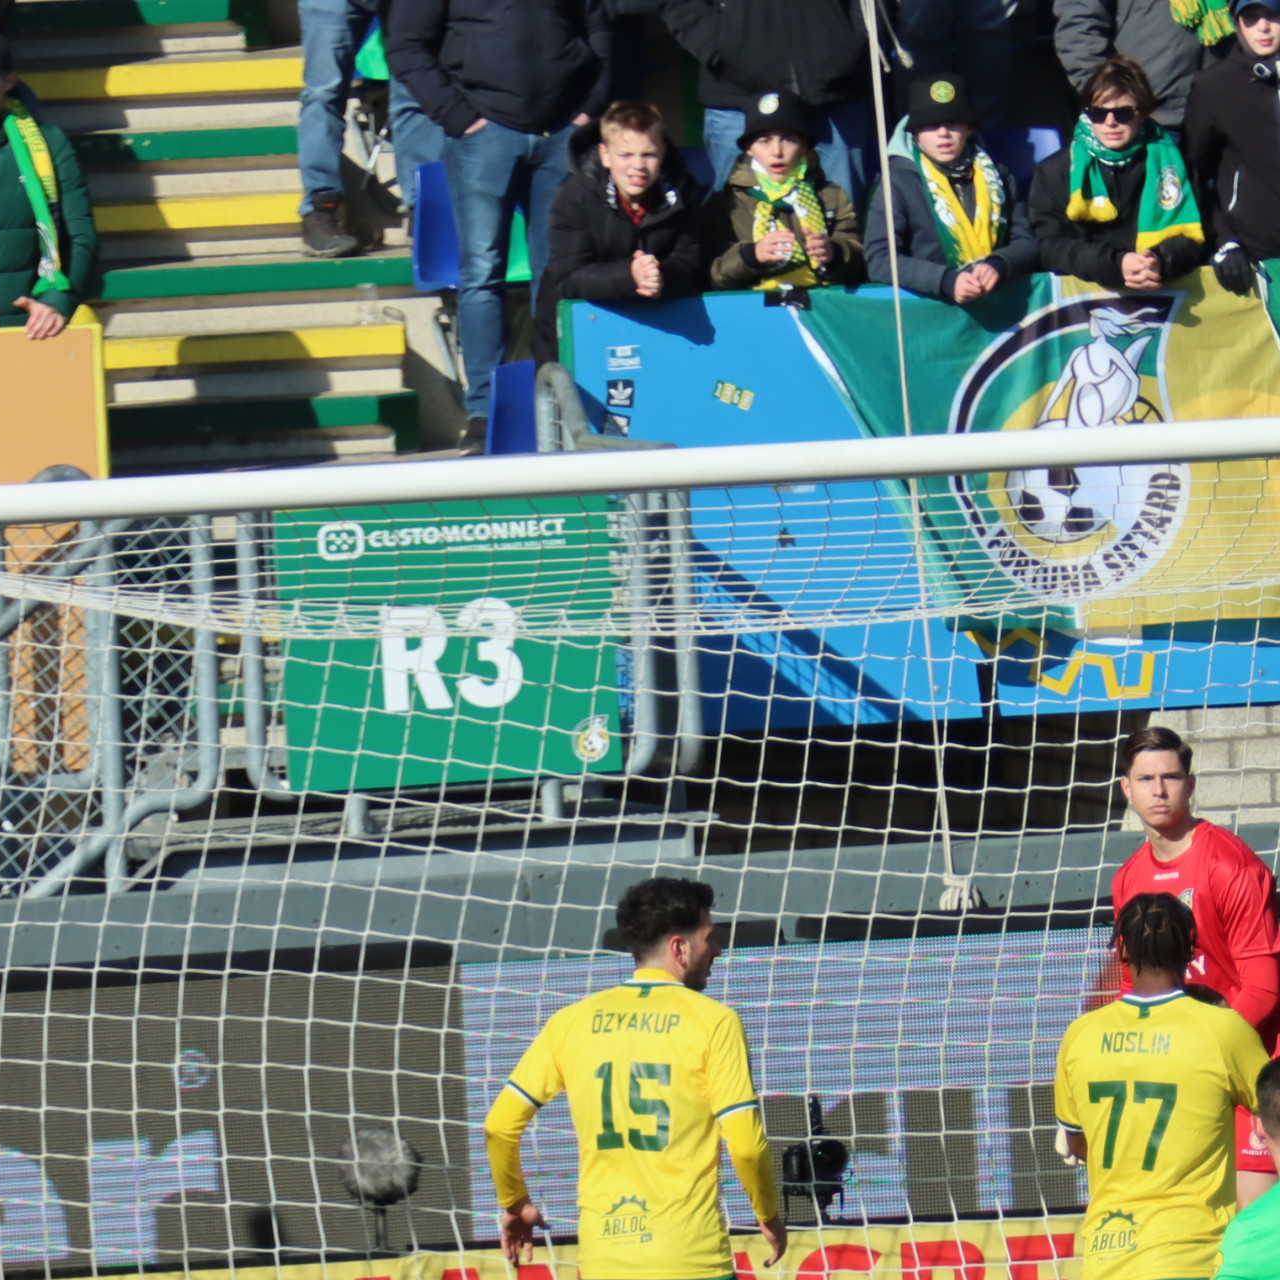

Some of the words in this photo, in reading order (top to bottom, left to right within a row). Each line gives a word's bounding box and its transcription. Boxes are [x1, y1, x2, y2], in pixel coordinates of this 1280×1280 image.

[368, 518, 566, 548] CUSTOMCONNECT
[380, 598, 524, 713] R3
[1100, 1031, 1172, 1056] NOSLIN
[594, 1061, 672, 1153] 15
[1087, 1080, 1178, 1173] 77
[601, 1214, 648, 1237] ABLOC
[1090, 1228, 1137, 1253] ABLOC
